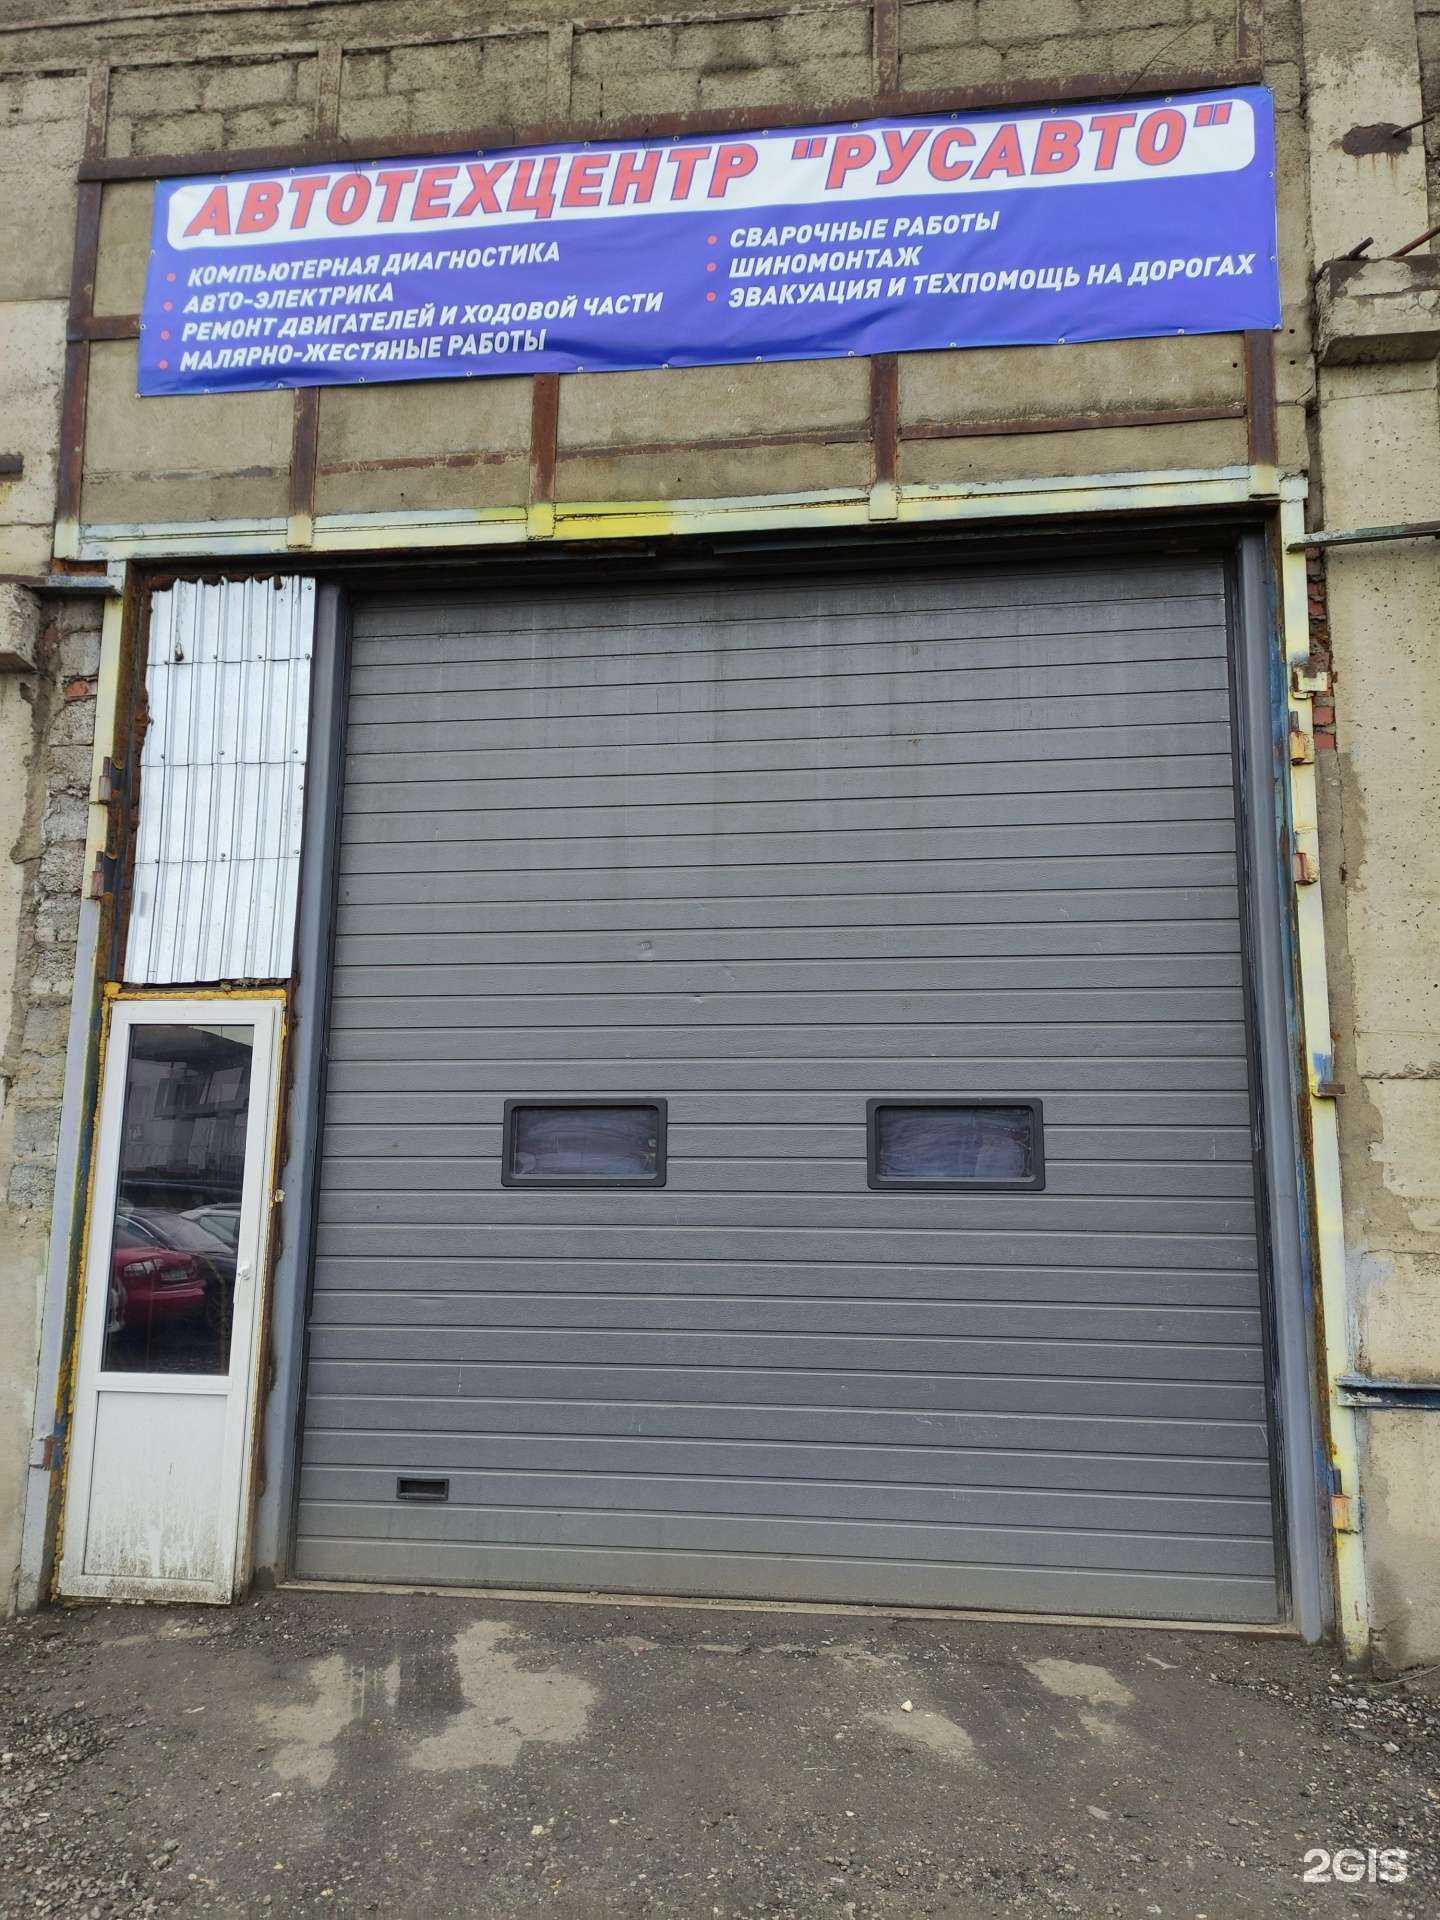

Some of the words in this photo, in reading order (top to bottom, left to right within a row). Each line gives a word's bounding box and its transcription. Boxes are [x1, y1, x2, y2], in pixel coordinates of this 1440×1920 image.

[183, 143, 759, 238] АВТОТЕХЦЕНТР
[792, 102, 1233, 190] "РУСАВТО"
[730, 218, 887, 248] СВАРОЧНЫЕ
[893, 210, 1000, 237] РАБОТЫ
[187, 254, 381, 287] КОМПЬЮТЕРНАЯ
[382, 241, 560, 276] ДИАГНОСТИКА
[728, 245, 923, 278] ШИНОМОНТАЖ
[728, 278, 882, 308] ЭВАКУАЦИЯ
[887, 276, 905, 297] И
[913, 264, 1081, 296] ТЕХПОМОЩЬ
[1087, 262, 1122, 286] НА
[1127, 253, 1255, 287] ДОРОГАХ
[181, 317, 276, 342] РЕМОНТ
[278, 303, 434, 339] ДВИГАТЕЛЕЙ
[439, 304, 456, 327] И
[460, 294, 578, 324] ХОДОВОЙ
[582, 291, 663, 317] ЧАСТИ
[183, 283, 394, 315] АВТО-ЭЛЕКТРИКА
[180, 335, 443, 372] МАЛЯРНО-ЖЕСТЯНЫЕ
[447, 328, 546, 356] РАБОТЫ
